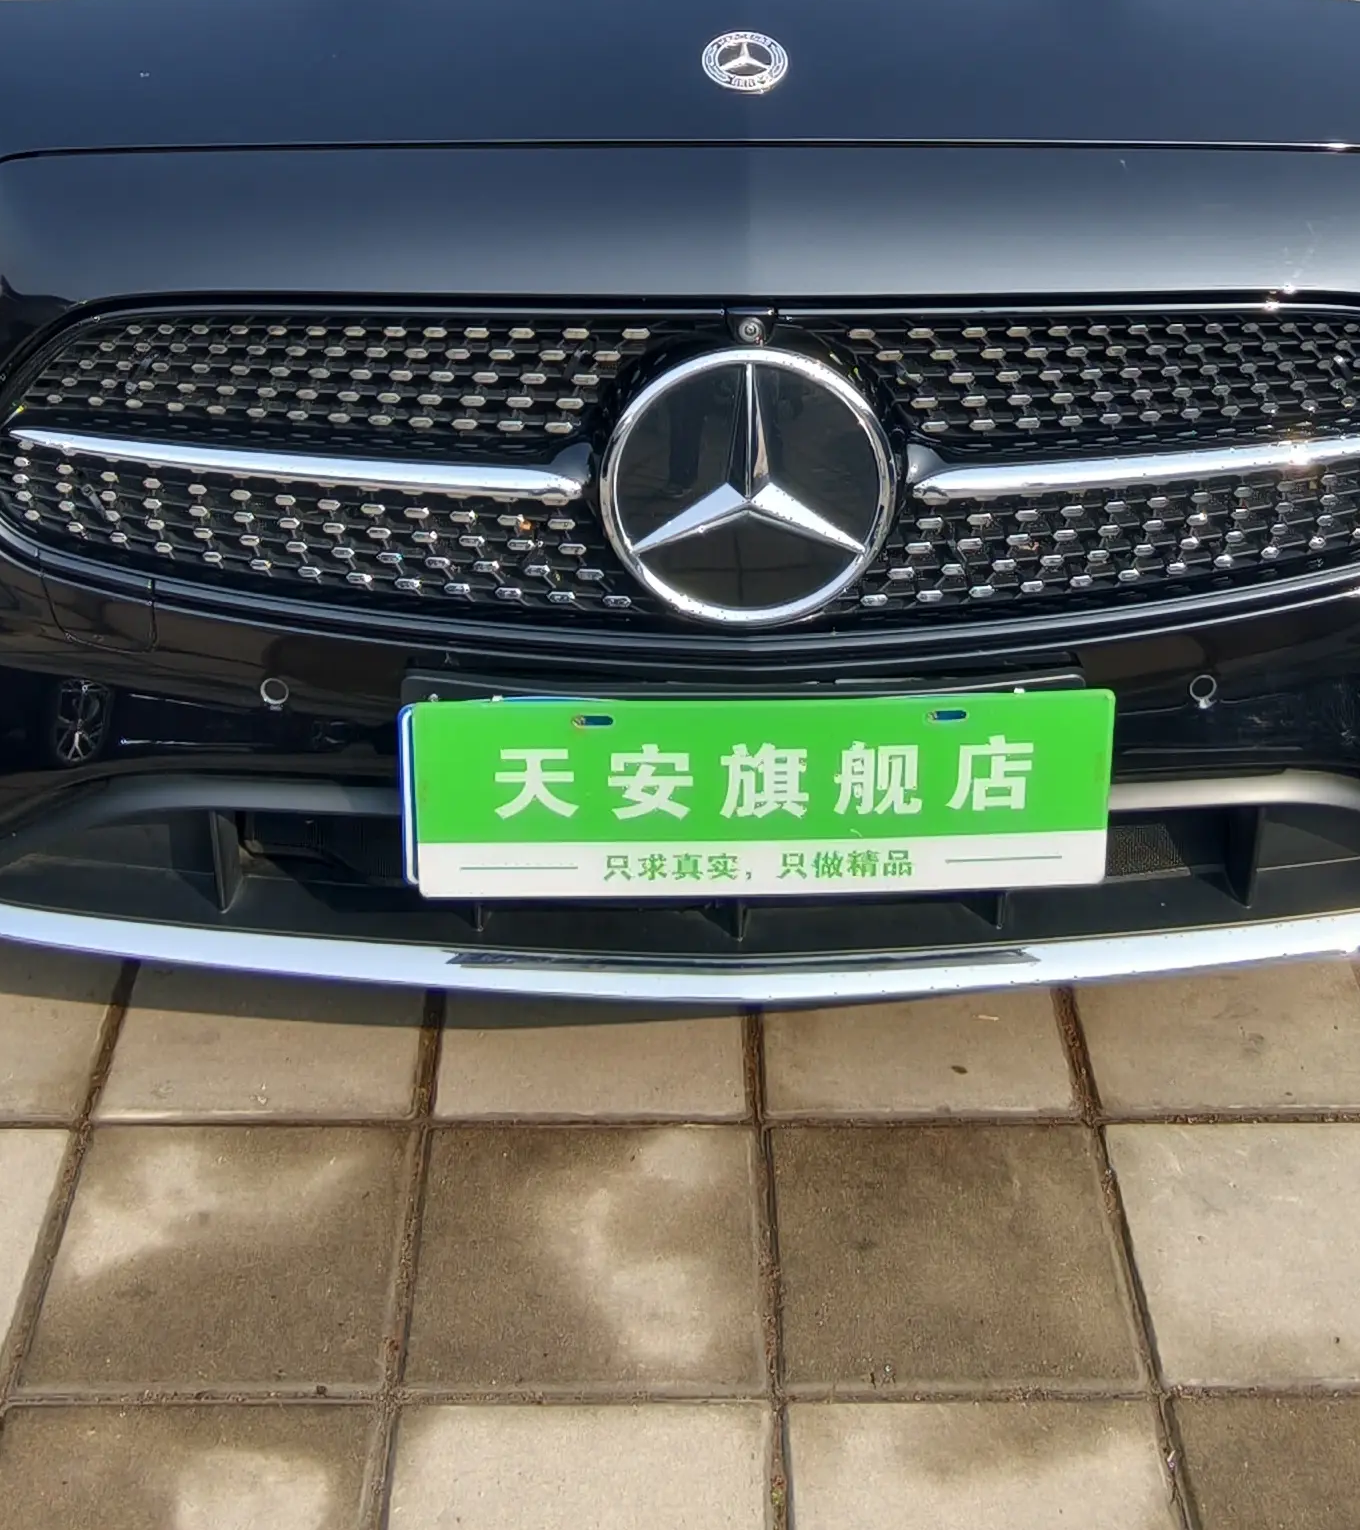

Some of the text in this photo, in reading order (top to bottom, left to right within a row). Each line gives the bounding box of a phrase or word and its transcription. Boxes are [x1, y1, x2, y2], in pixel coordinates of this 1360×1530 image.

[492, 734, 1037, 821] 天安旗舰店
